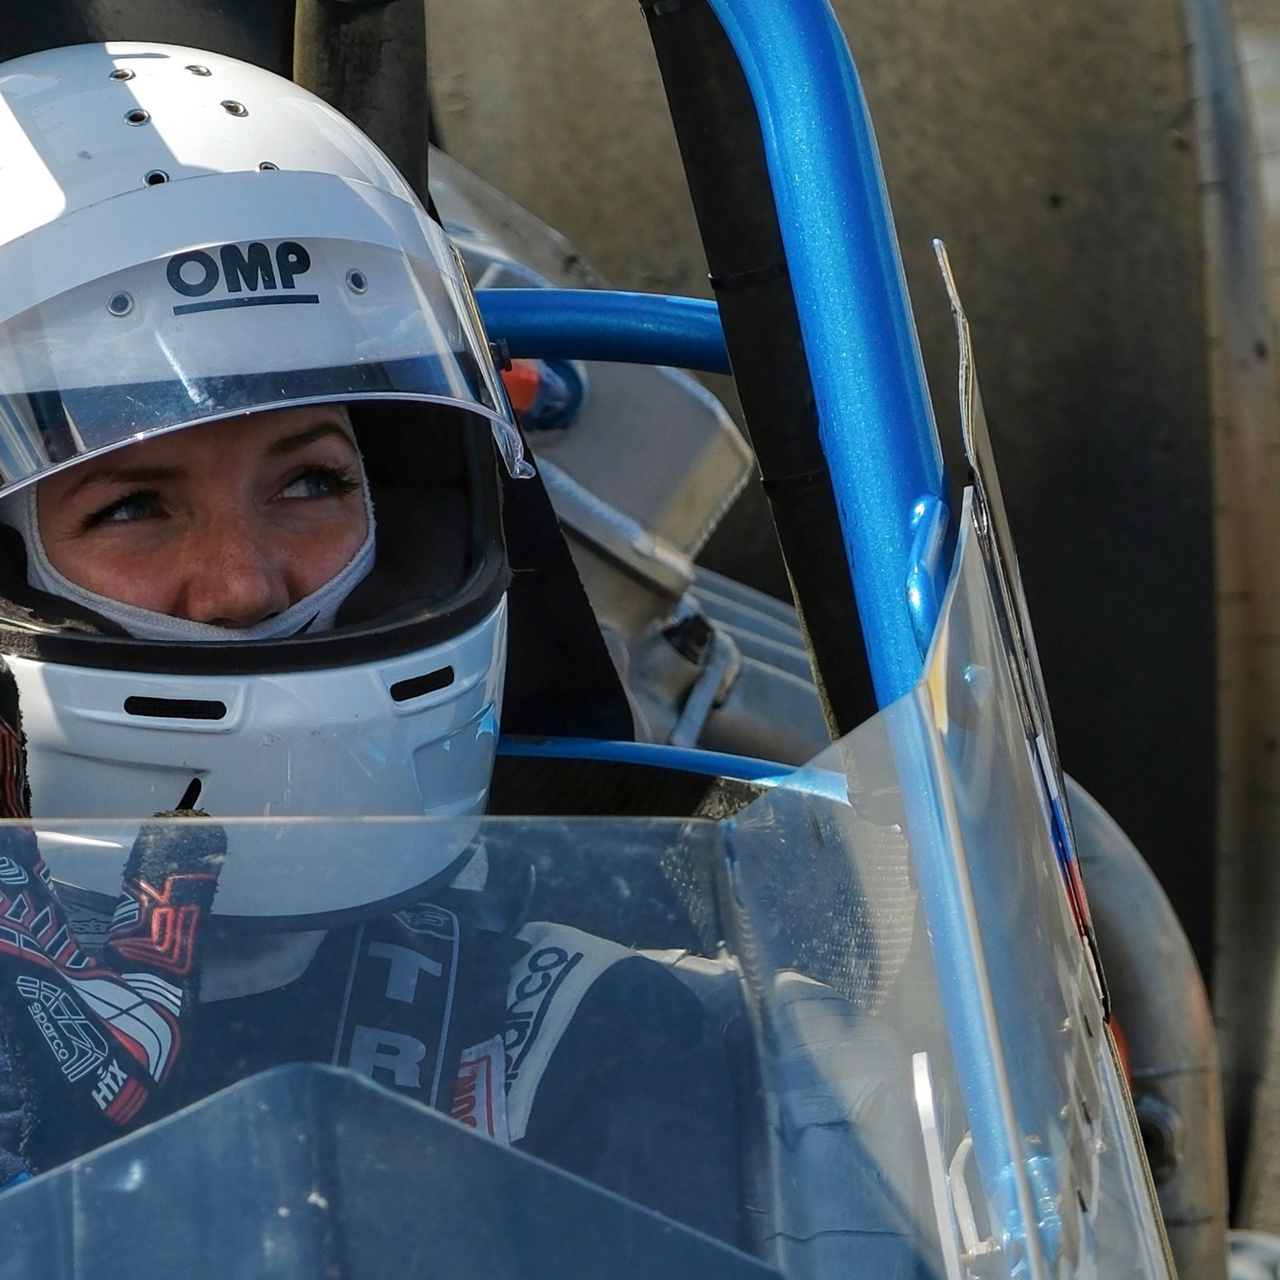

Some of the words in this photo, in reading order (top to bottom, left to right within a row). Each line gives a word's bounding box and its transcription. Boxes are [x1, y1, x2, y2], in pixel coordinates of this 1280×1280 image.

[165, 241, 311, 297] OMP
[29, 1001, 70, 1062] sparco
[505, 946, 570, 1096] arco
